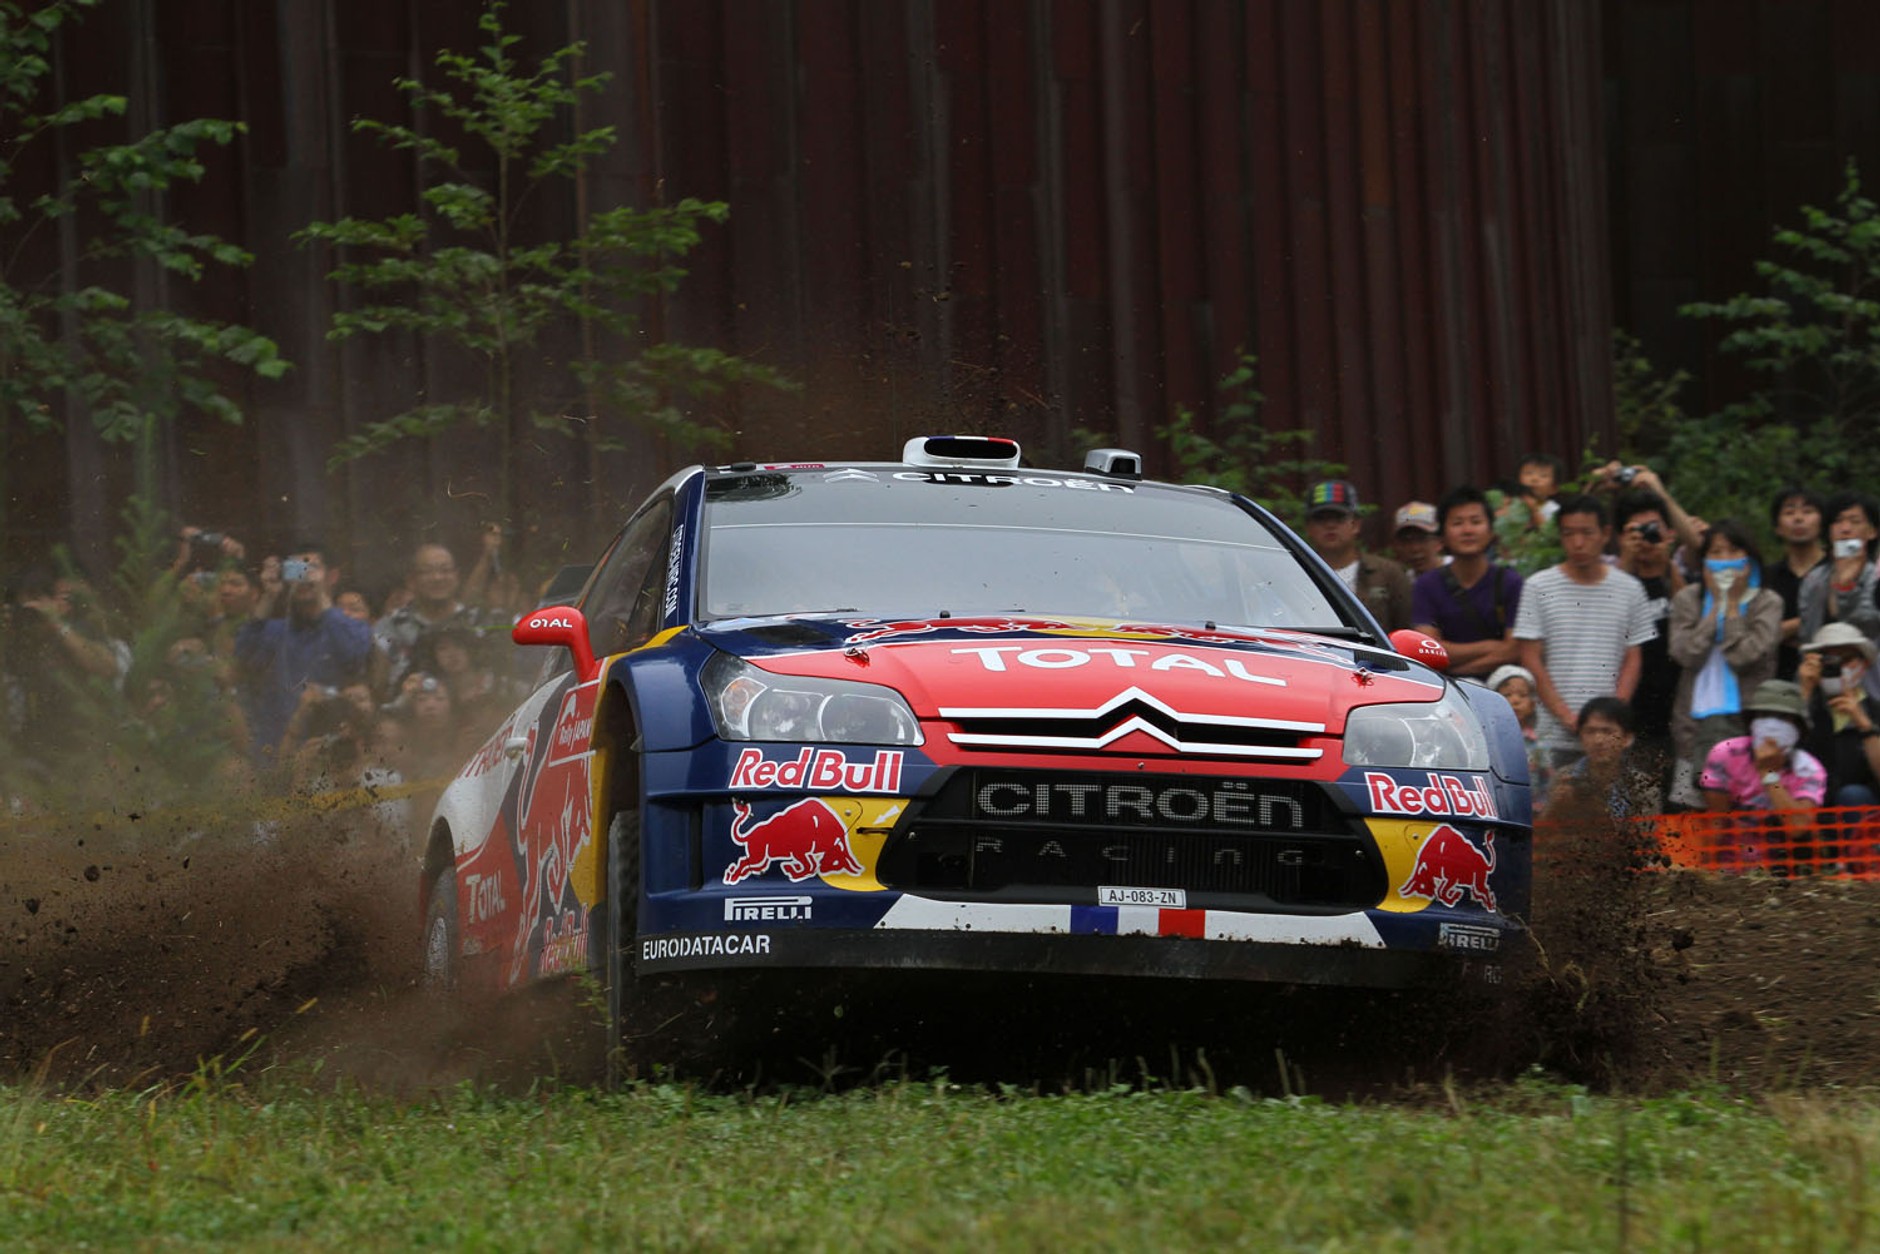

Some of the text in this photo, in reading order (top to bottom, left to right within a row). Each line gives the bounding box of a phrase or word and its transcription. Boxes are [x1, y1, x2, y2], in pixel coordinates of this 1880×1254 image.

[951, 646, 1288, 687] TOTAL
[728, 747, 904, 793] Red Bull
[1364, 771, 1498, 819] Red Bull
[466, 869, 506, 924] TOTAL
[724, 896, 813, 921] PIRELLI
[1108, 889, 1177, 905] AJ-083-ZN
[643, 935, 770, 960] EURODATACAR
